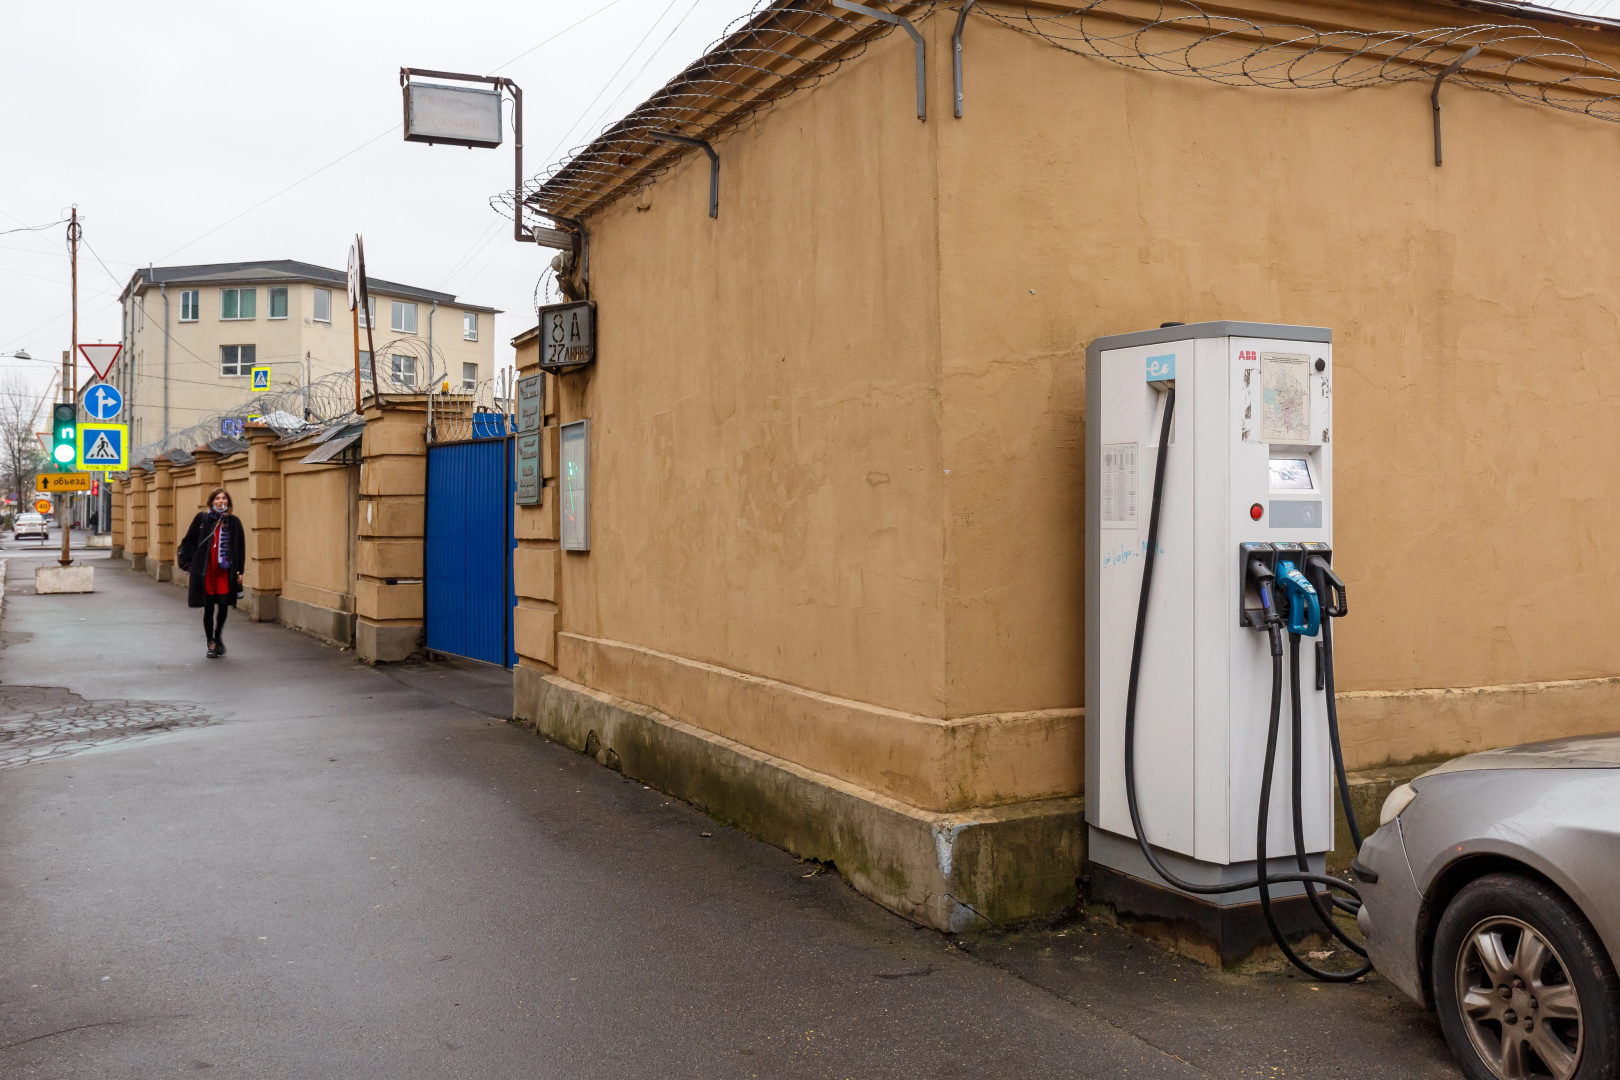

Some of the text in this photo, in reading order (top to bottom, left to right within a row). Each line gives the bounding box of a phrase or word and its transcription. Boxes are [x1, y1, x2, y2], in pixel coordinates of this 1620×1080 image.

[552, 312, 581, 343] 8 А
[548, 343, 566, 363] 27
[1238, 350, 1257, 361] ABB
[53, 476, 86, 486] объезд
